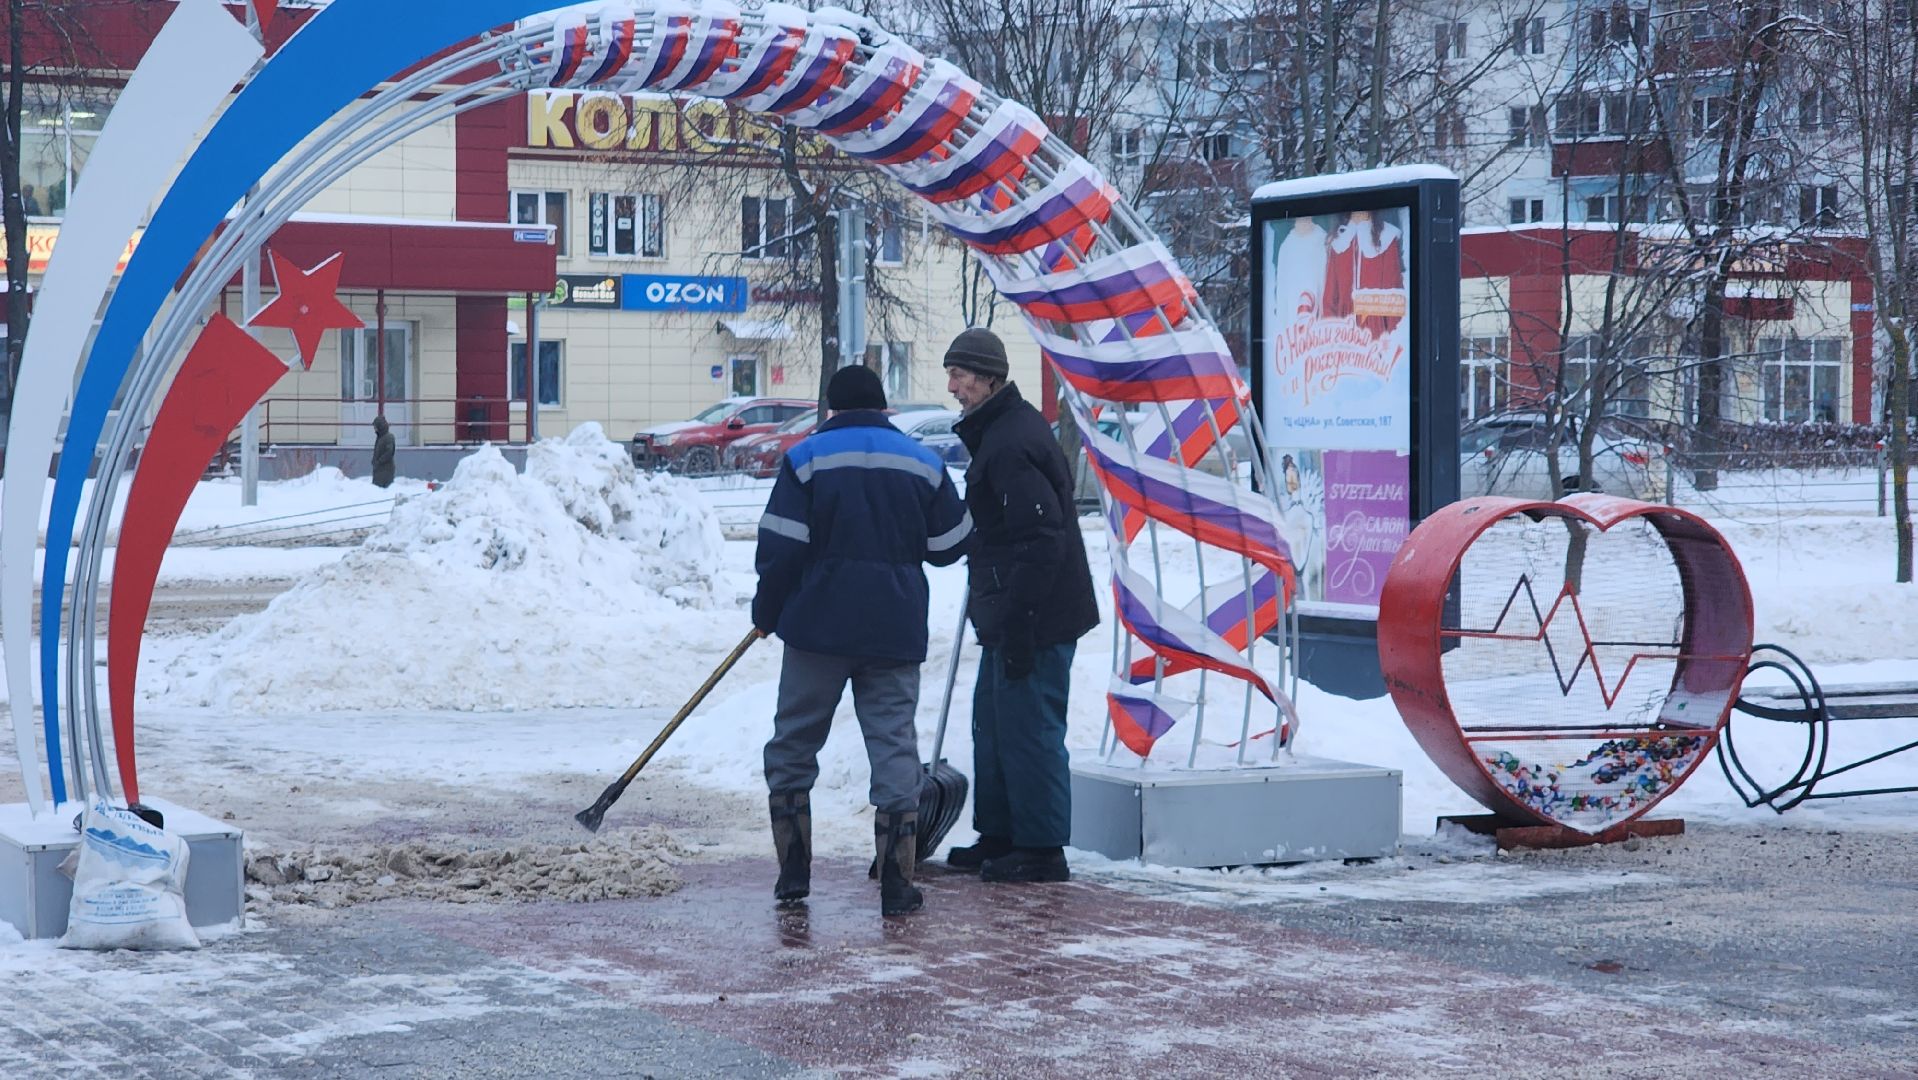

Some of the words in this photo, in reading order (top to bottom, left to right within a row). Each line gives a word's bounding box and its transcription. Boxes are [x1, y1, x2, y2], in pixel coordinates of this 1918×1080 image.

[646, 282, 724, 303] OZON
[1379, 415, 1392, 426] 187
[1329, 483, 1403, 501] SVETLANA
